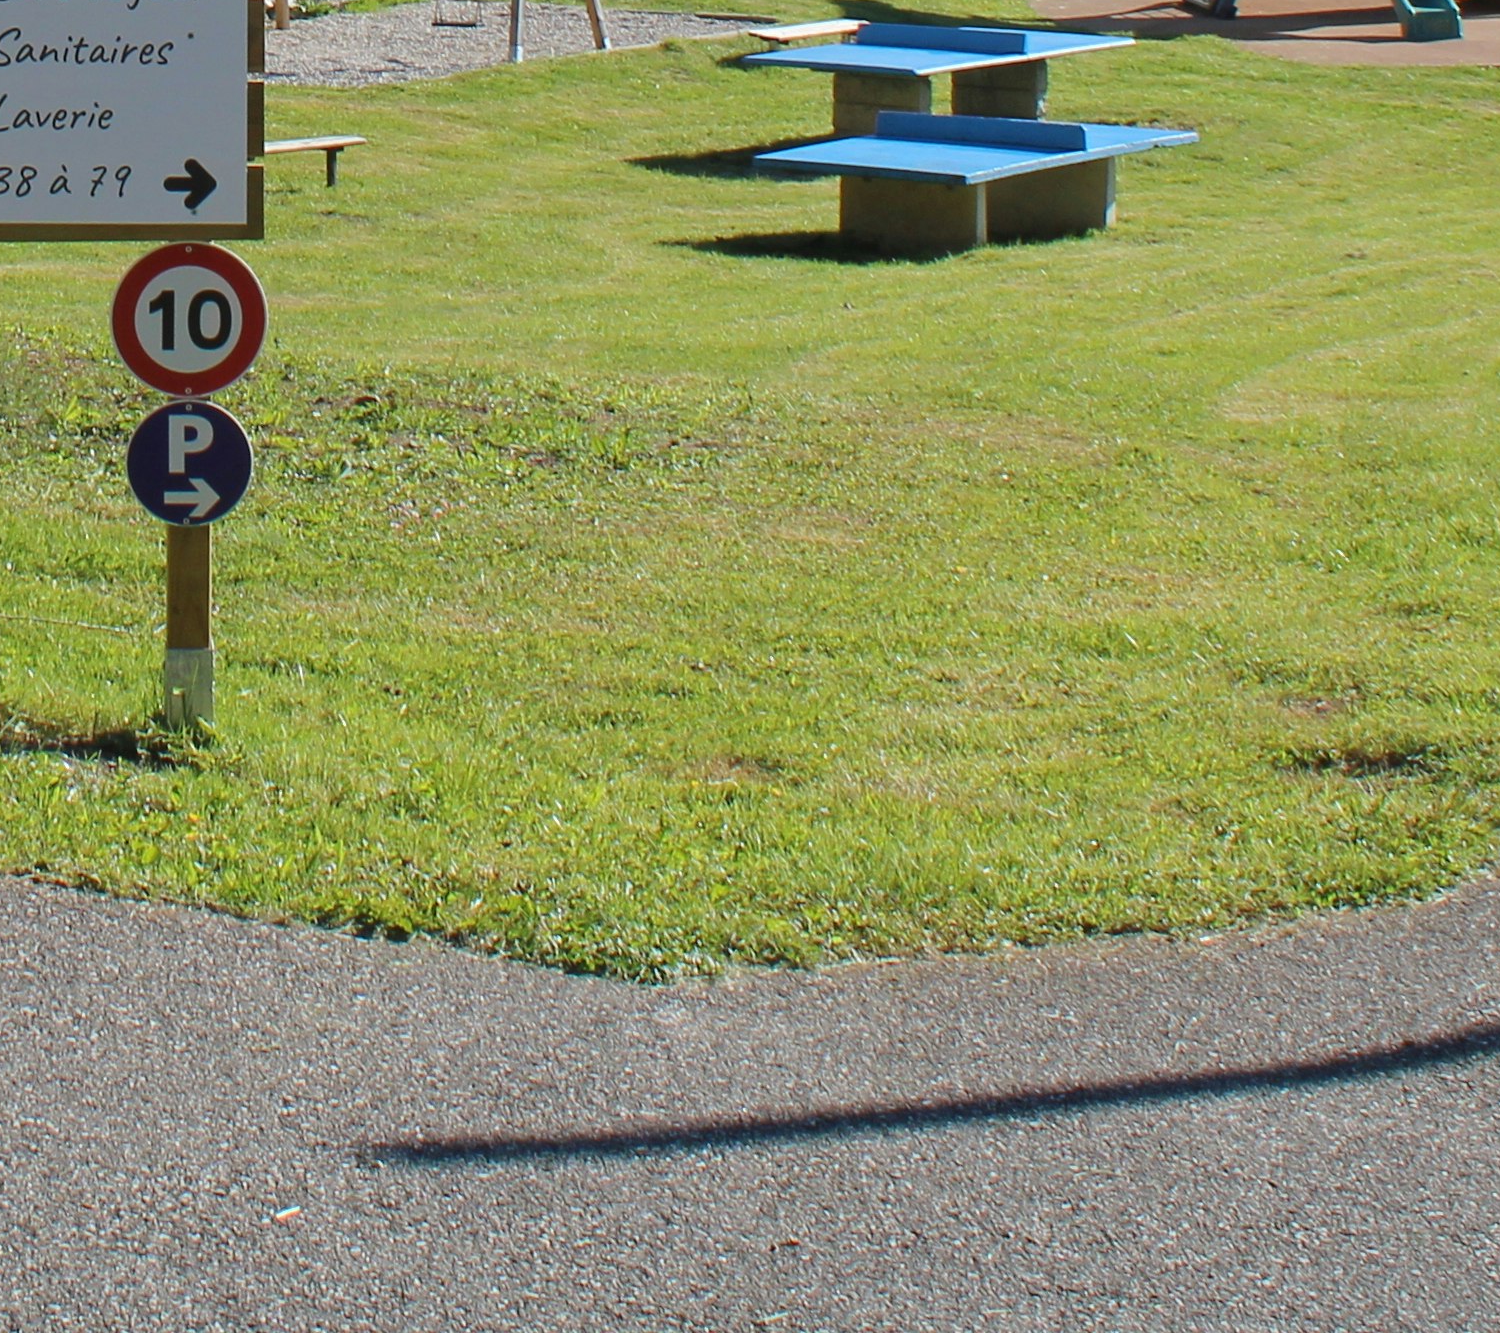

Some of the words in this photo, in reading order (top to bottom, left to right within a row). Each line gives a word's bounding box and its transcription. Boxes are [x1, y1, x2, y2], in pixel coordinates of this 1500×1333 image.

[49, 164, 72, 195] à
[90, 165, 132, 198] 79
[148, 289, 232, 351] 10
[168, 414, 214, 474] P
